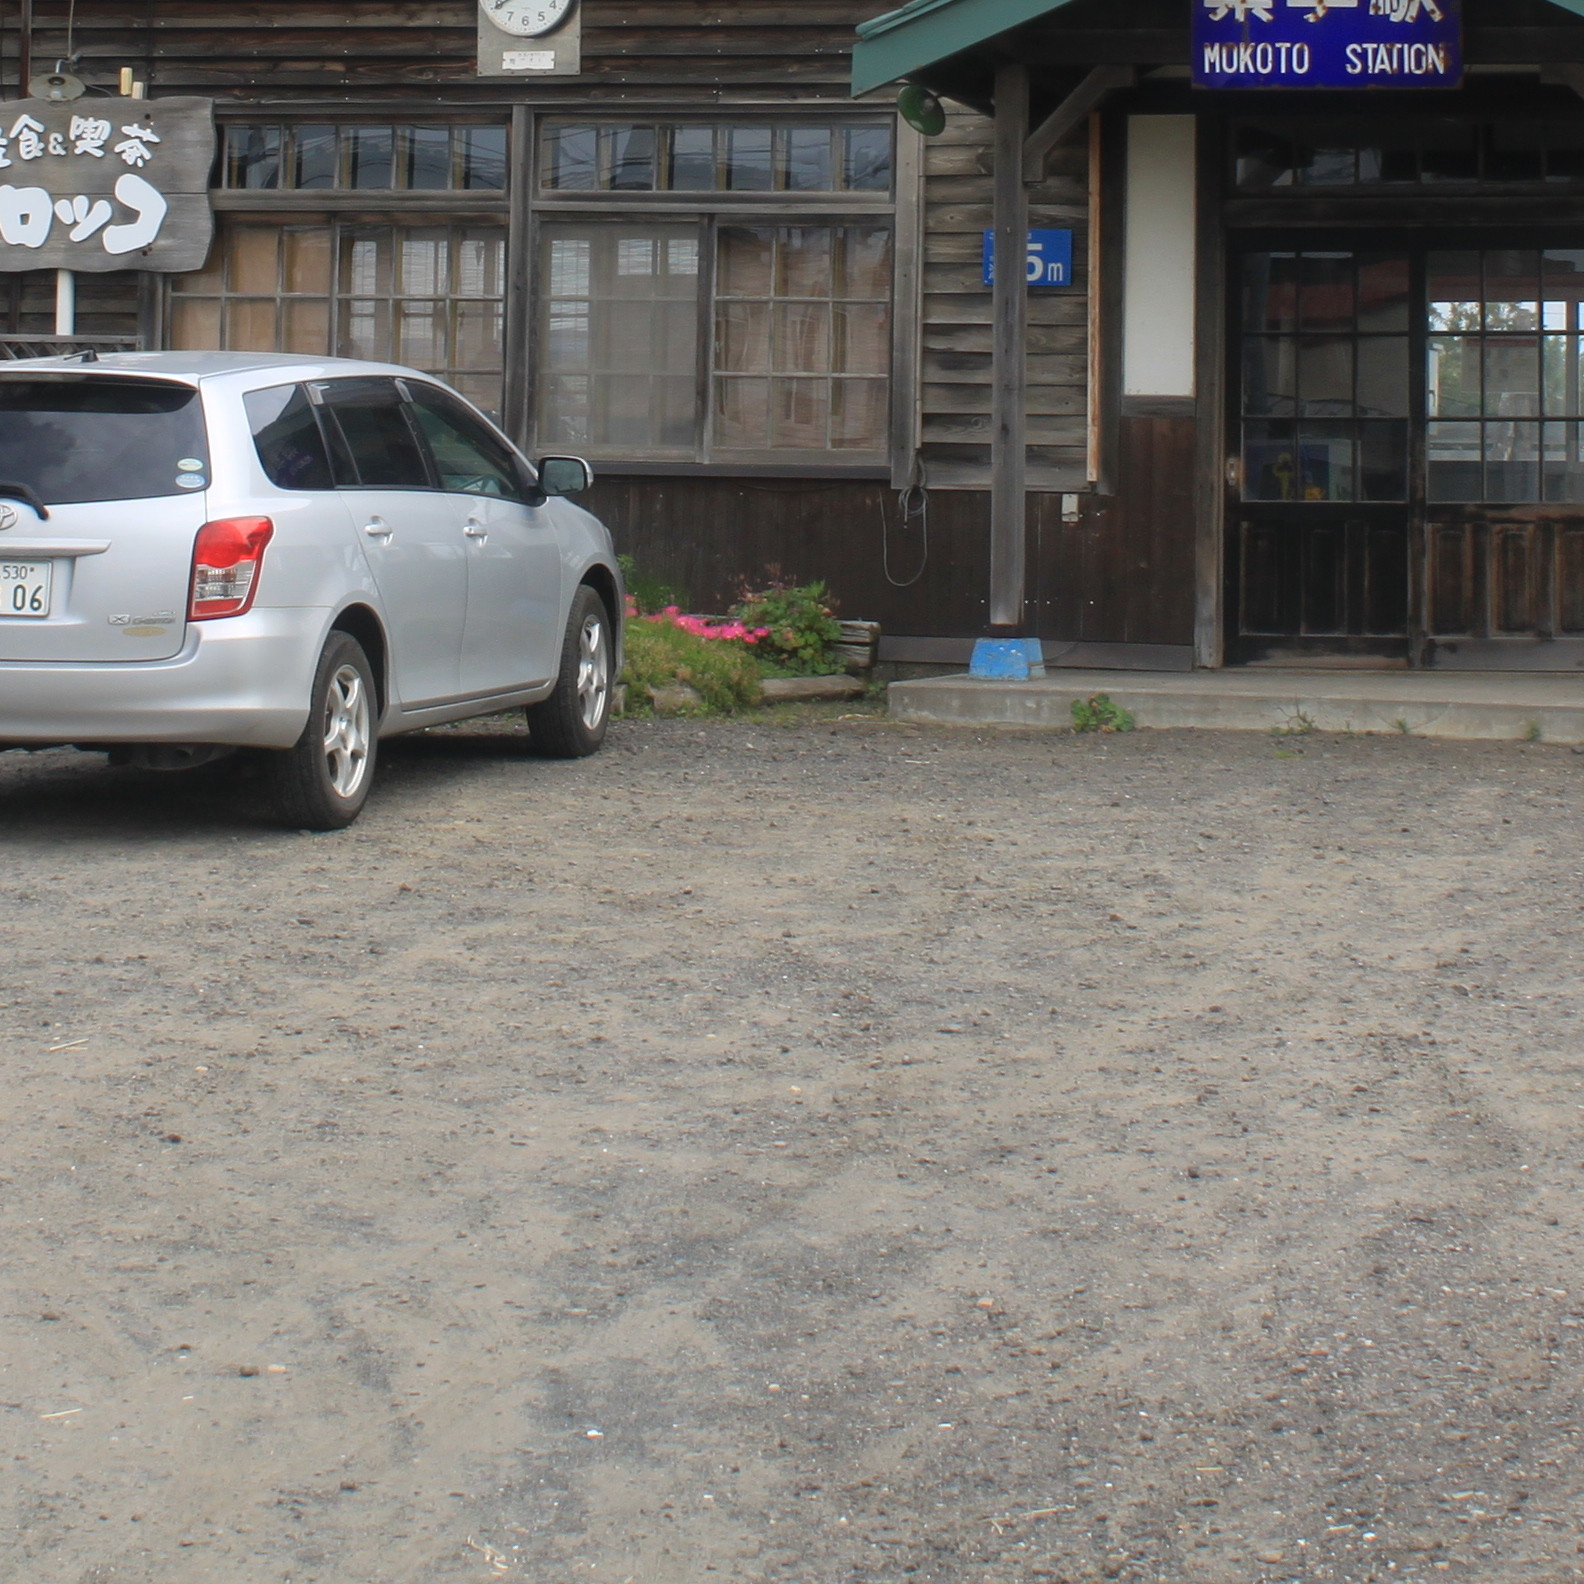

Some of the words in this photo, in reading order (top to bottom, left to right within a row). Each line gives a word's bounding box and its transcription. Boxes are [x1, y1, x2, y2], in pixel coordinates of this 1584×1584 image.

[549, 0, 557, 10] 4
[507, 11, 515, 22] 7
[521, 15, 529, 26] 6
[537, 11, 546, 22] 5
[1345, 42, 1445, 75] STATION
